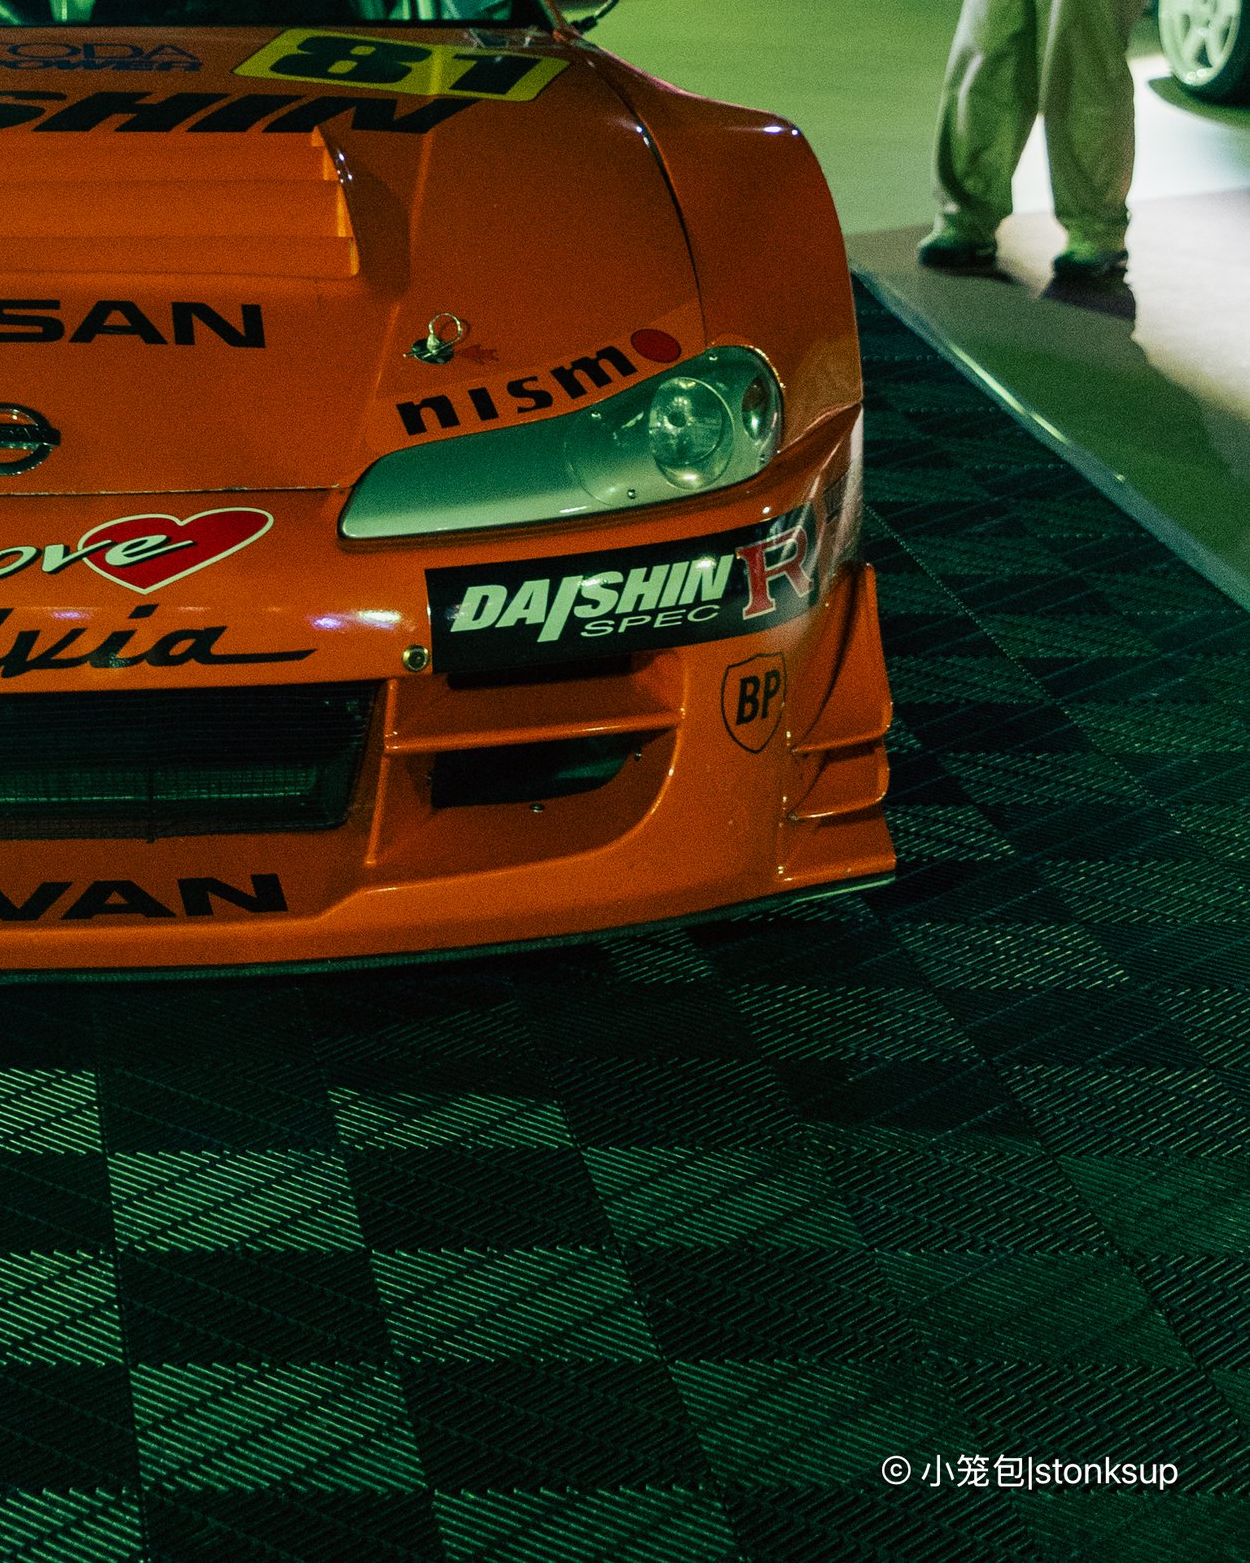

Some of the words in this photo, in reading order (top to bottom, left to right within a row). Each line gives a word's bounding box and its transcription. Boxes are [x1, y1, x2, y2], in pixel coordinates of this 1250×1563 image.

[270, 33, 542, 95] 81
[449, 554, 734, 642] DAISHIN
[582, 604, 720, 638] SPEC
[736, 532, 812, 622] R
[733, 668, 783, 726] BP
